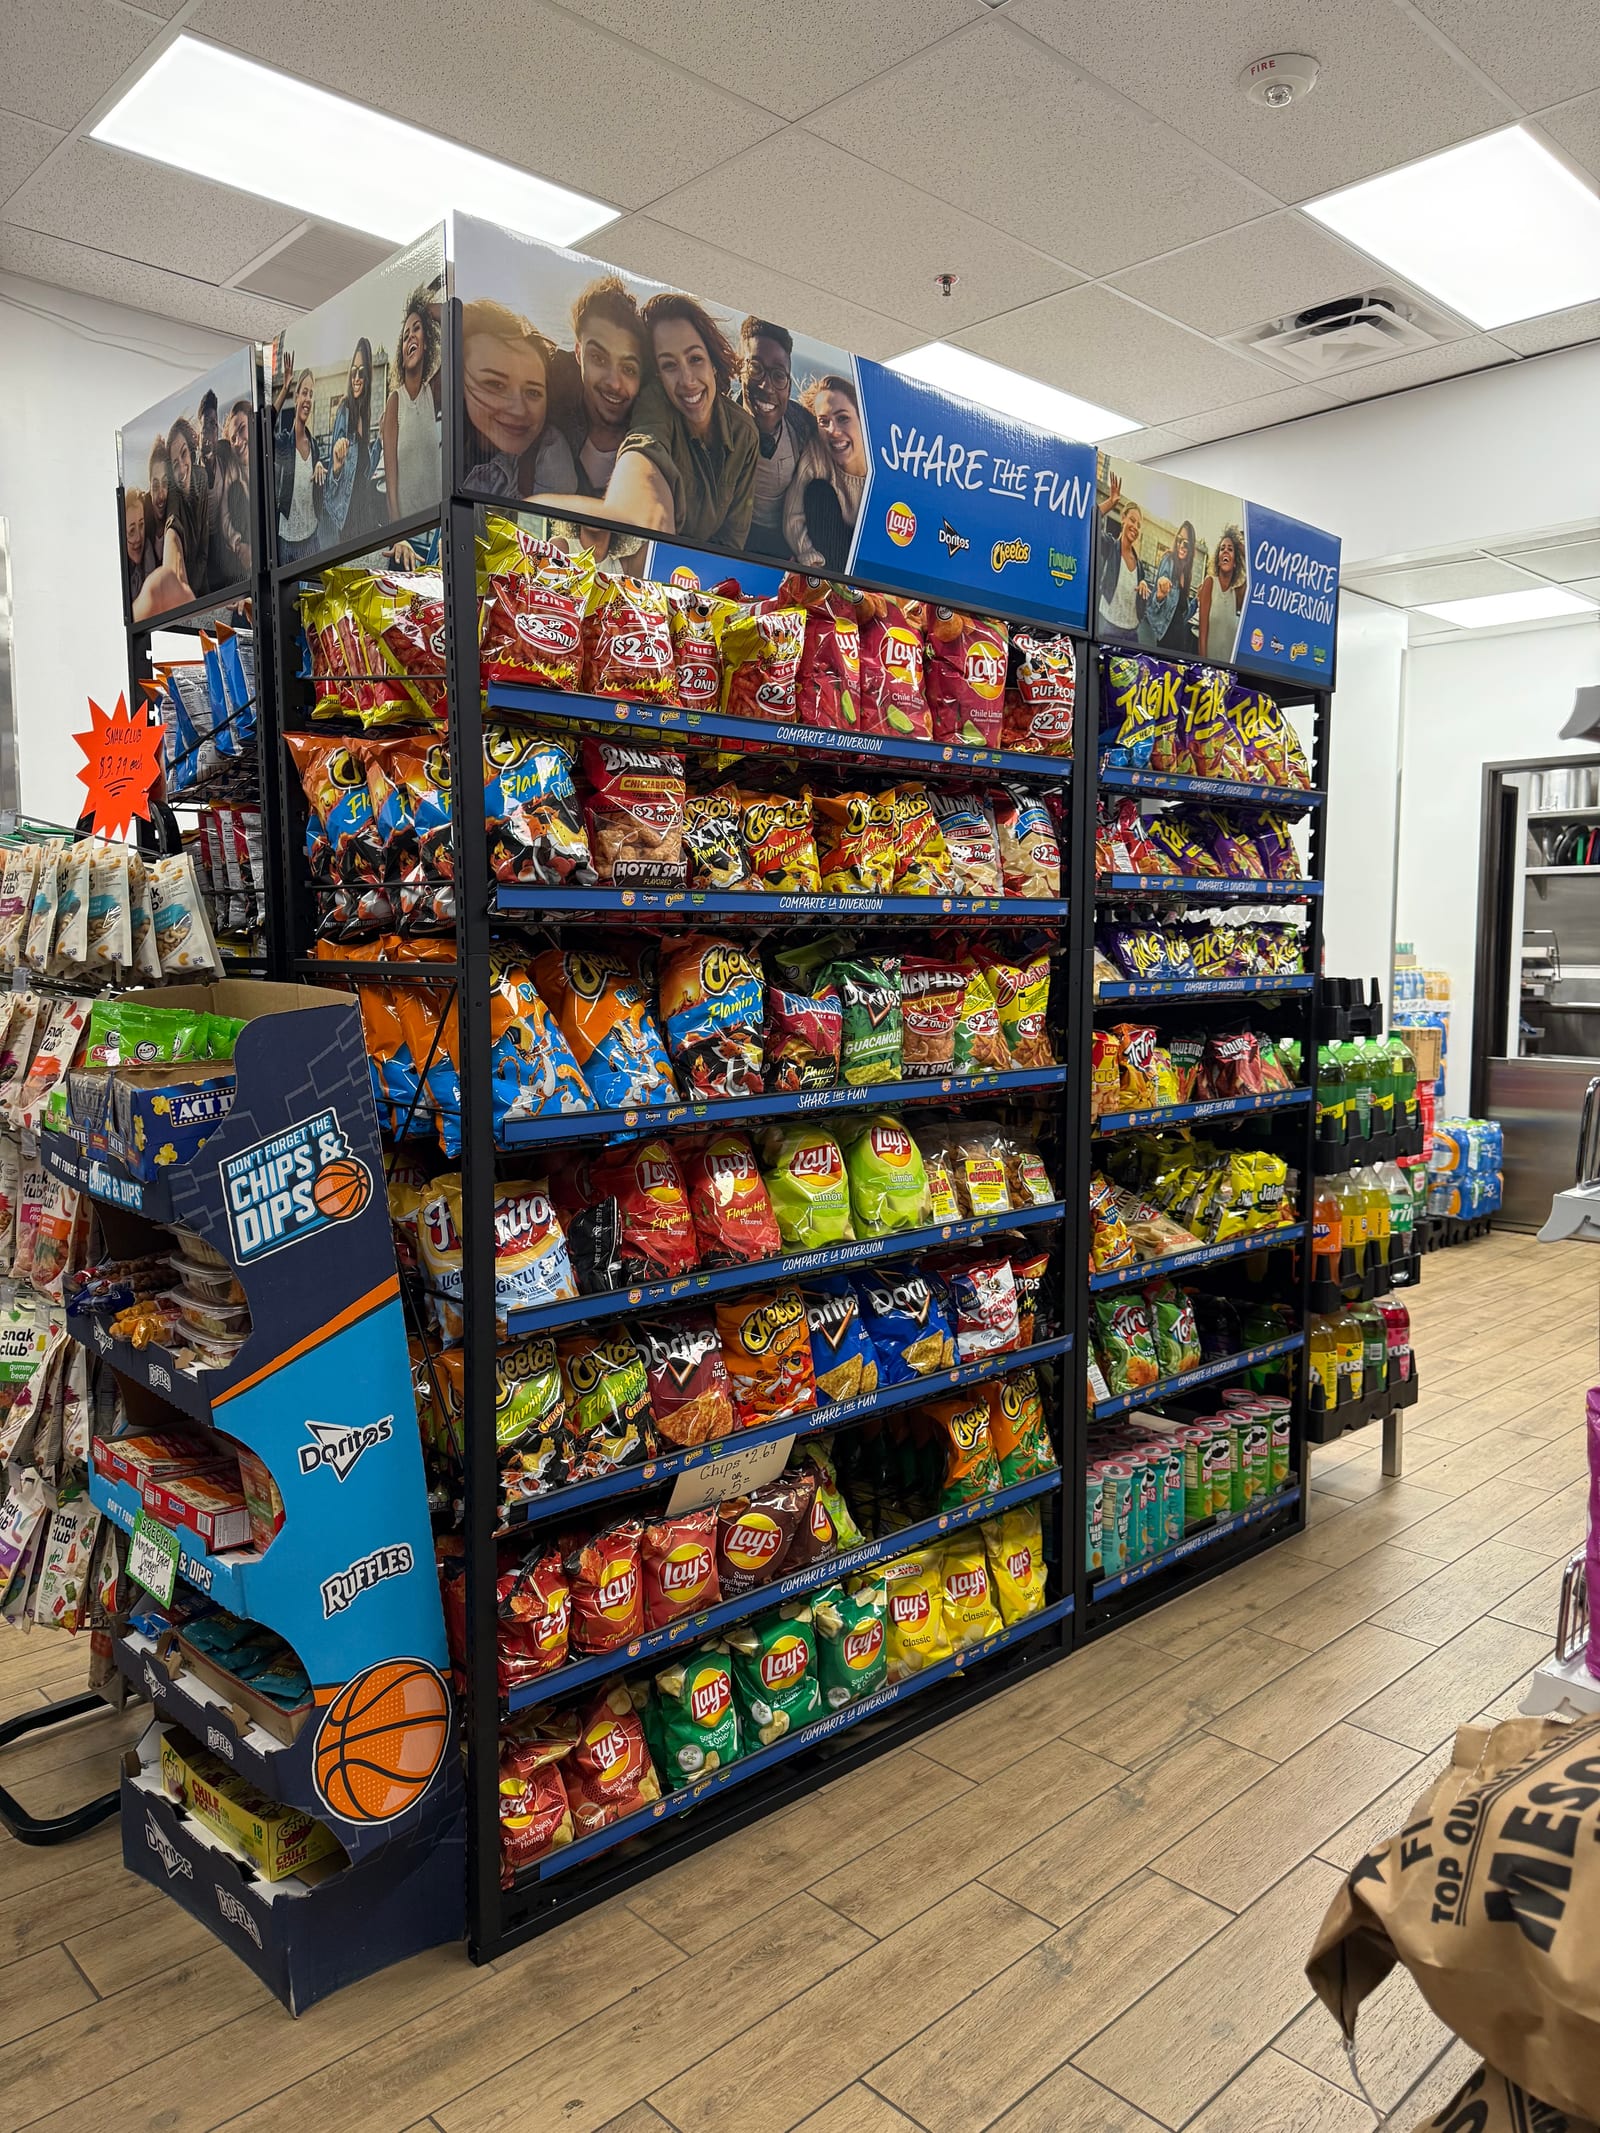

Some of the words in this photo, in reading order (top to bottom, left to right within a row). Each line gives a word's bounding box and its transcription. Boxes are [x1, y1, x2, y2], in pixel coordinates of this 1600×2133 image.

[1251, 60, 1276, 76] FIRE
[881, 424, 989, 491] SHARE
[992, 458, 1031, 491] THE
[1033, 470, 1092, 520] FUN
[888, 511, 916, 537] Lay's
[938, 530, 970, 551] Doritos
[992, 539, 1030, 572] Cheetos
[1254, 540, 1338, 595] COMPARTE
[1253, 582, 1266, 602] LA
[1267, 585, 1335, 626] DIVERSIÓN
[547, 629, 577, 649] ONLY
[886, 636, 924, 675] Lay's
[692, 677, 716, 691] ONLY
[967, 657, 1007, 686] Lay's
[123, 728, 142, 744] CLUB
[776, 726, 824, 744] COMPARTE
[827, 733, 836, 745] LA
[837, 734, 883, 751] DIVERSIÓN
[616, 863, 658, 877] HOT'N
[643, 878, 672, 886] FLAVORED
[779, 896, 825, 909] COMPARTE
[828, 898, 837, 908] LA
[839, 897, 883, 910] DIVERSIÓN
[179, 1097, 215, 1120] ACT
[797, 1091, 830, 1108] SHARE
[833, 1090, 845, 1100] THE
[847, 1087, 868, 1101] FUN
[227, 1150, 264, 1179] DON'T
[265, 1128, 308, 1159] FORGET
[309, 1115, 332, 1137] THE
[875, 1126, 910, 1156] Lay's
[230, 1144, 314, 1212] CHIPS
[318, 1132, 345, 1166] &
[711, 1153, 756, 1180] Lay's
[793, 1143, 840, 1176] Lay's
[50, 1151, 62, 1169] DON'T
[79, 1168, 88, 1183] THE
[112, 1176, 119, 1198] &
[120, 1181, 141, 1206] DIPS
[643, 1161, 674, 1190] Lay's
[235, 1179, 318, 1254] DIPS
[782, 1252, 828, 1271] COMPARTE
[830, 1250, 840, 1262] LA
[840, 1241, 884, 1260] DIVERSIÓN
[2, 1328, 35, 1341] snak
[9, 1364, 35, 1373] gummy
[10, 1372, 30, 1380] bears
[809, 1407, 842, 1427] SHARE
[857, 1395, 878, 1409] FUN
[300, 1415, 391, 1474] Doritos
[700, 1460, 741, 1481] Chips
[731, 1472, 742, 1480] OR
[702, 1487, 715, 1504] 2
[55, 1514, 78, 1531] snak
[141, 1517, 173, 1552] SPECIAL
[729, 1530, 781, 1556] Lay's
[179, 1552, 187, 1573] &
[189, 1558, 212, 1590] DIPS
[664, 1553, 710, 1589] Lay's
[733, 1571, 755, 1582] Sweet
[781, 1567, 827, 1594] COMPARTE
[828, 1563, 838, 1576] LA
[838, 1543, 882, 1571] DIVERSIÓN
[886, 1564, 922, 1579] FLAVOR
[1009, 1549, 1032, 1580] Lay's
[323, 1545, 412, 1619] RUFFLES
[599, 1570, 636, 1608] Lay's
[949, 1568, 986, 1602] Lay's
[891, 1594, 930, 1626] Lay's
[962, 1608, 990, 1624] Classic
[845, 1623, 883, 1660] Lay's
[903, 1633, 931, 1648] Classic
[765, 1642, 806, 1683] Lay's
[693, 1674, 730, 1721] Lay's
[800, 1713, 847, 1744] COMPARTE
[847, 1709, 856, 1721] LA
[856, 1686, 899, 1716] DIVERSIÓN
[207, 1726, 234, 1760] RUFFLES
[192, 1779, 220, 1812] CHILE
[252, 1823, 263, 1840] 18
[504, 1831, 528, 1847] Sweet
[529, 1827, 535, 1838] &
[535, 1818, 553, 1835] Spicy
[520, 1832, 546, 1850] Honey
[145, 1823, 193, 1880] Doritos
[276, 1845, 307, 1866] CHILE
[276, 1854, 307, 1873] PICANTE
[1431, 1856, 1464, 1924] TOP
[215, 1884, 263, 1950] RUFFLES
